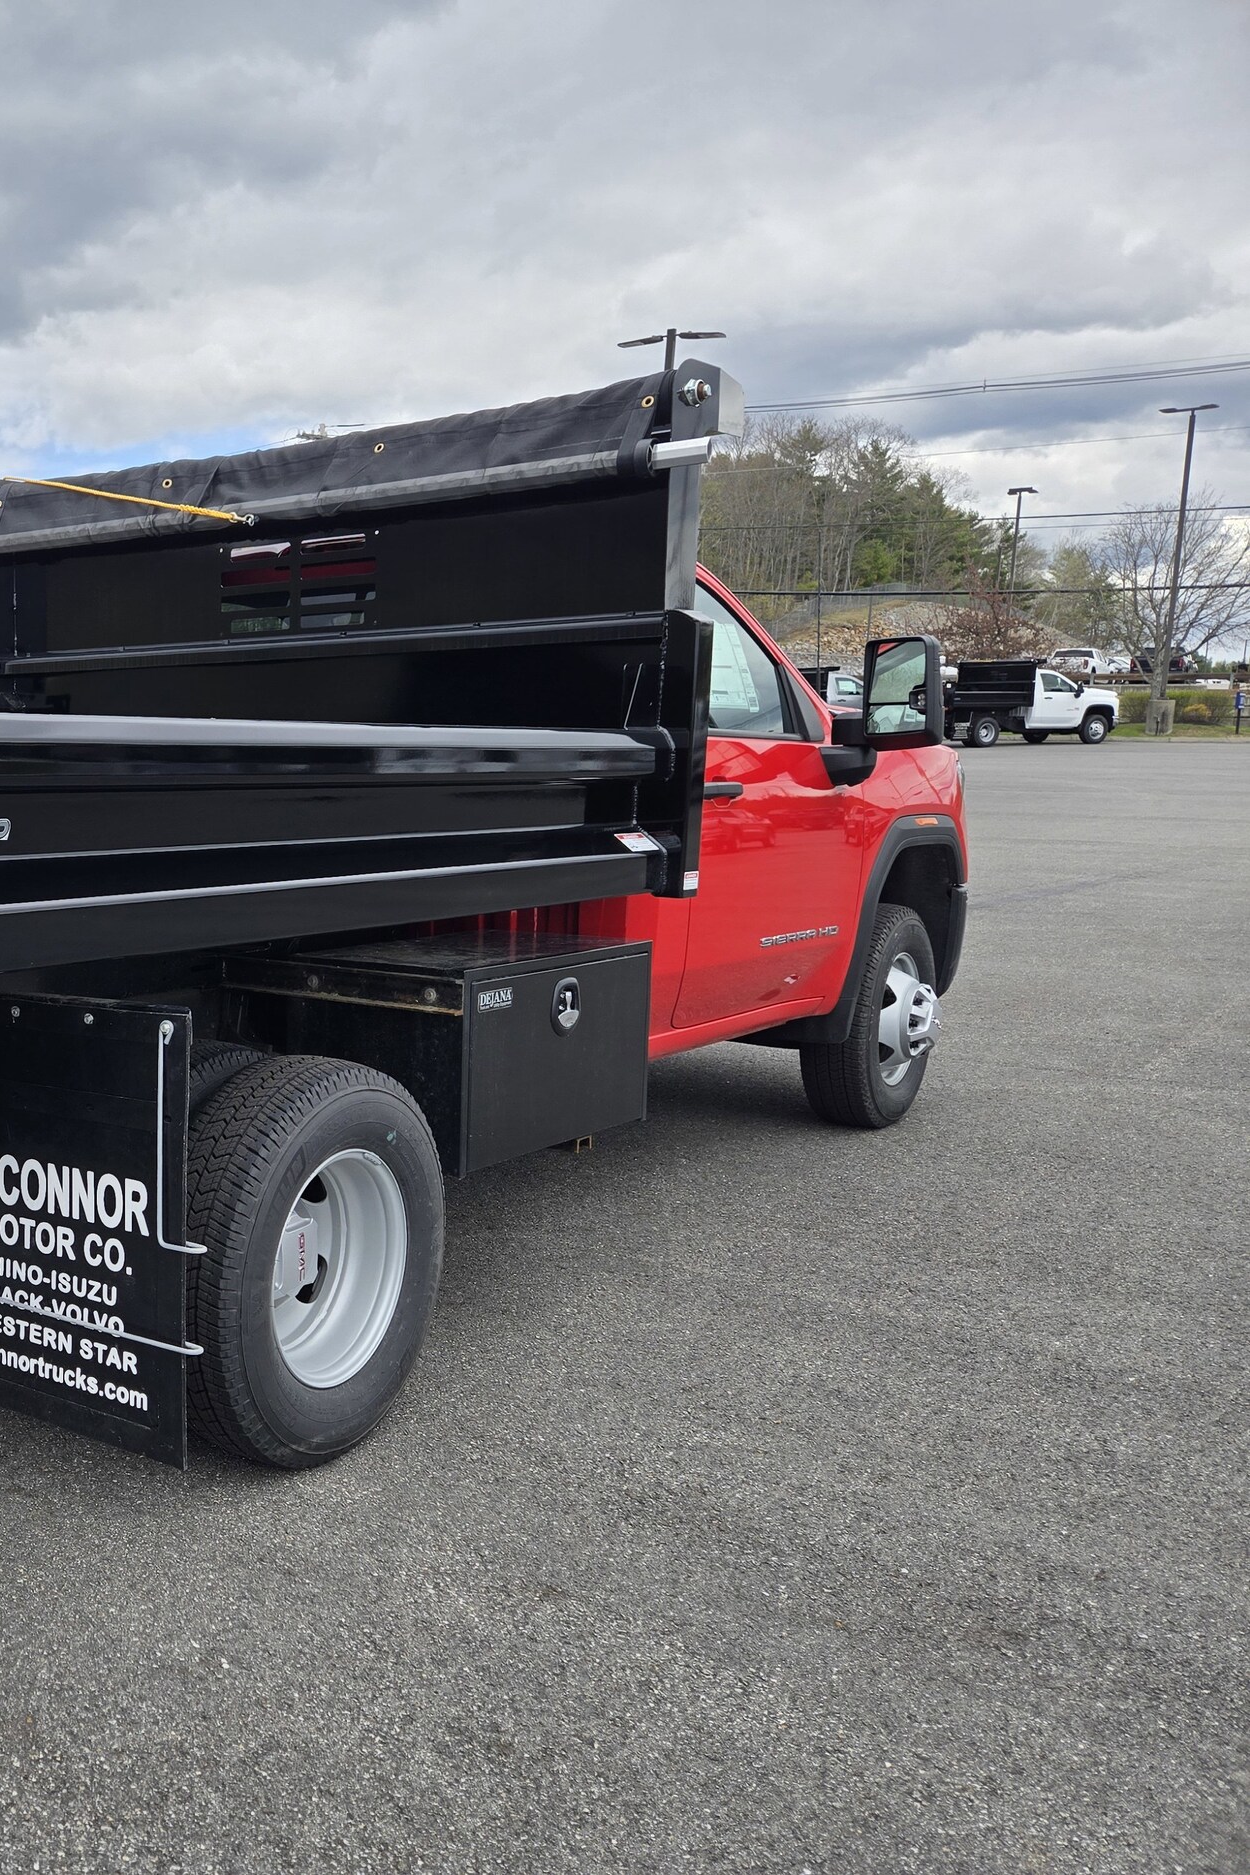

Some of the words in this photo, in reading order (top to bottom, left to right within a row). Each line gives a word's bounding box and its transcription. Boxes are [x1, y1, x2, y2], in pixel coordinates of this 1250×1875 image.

[760, 929, 817, 948] SIERRA
[819, 925, 839, 937] HD
[480, 989, 512, 1008] DEJANA
[84, 1233, 132, 1275] CO.
[79, 1338, 138, 1375] STAR
